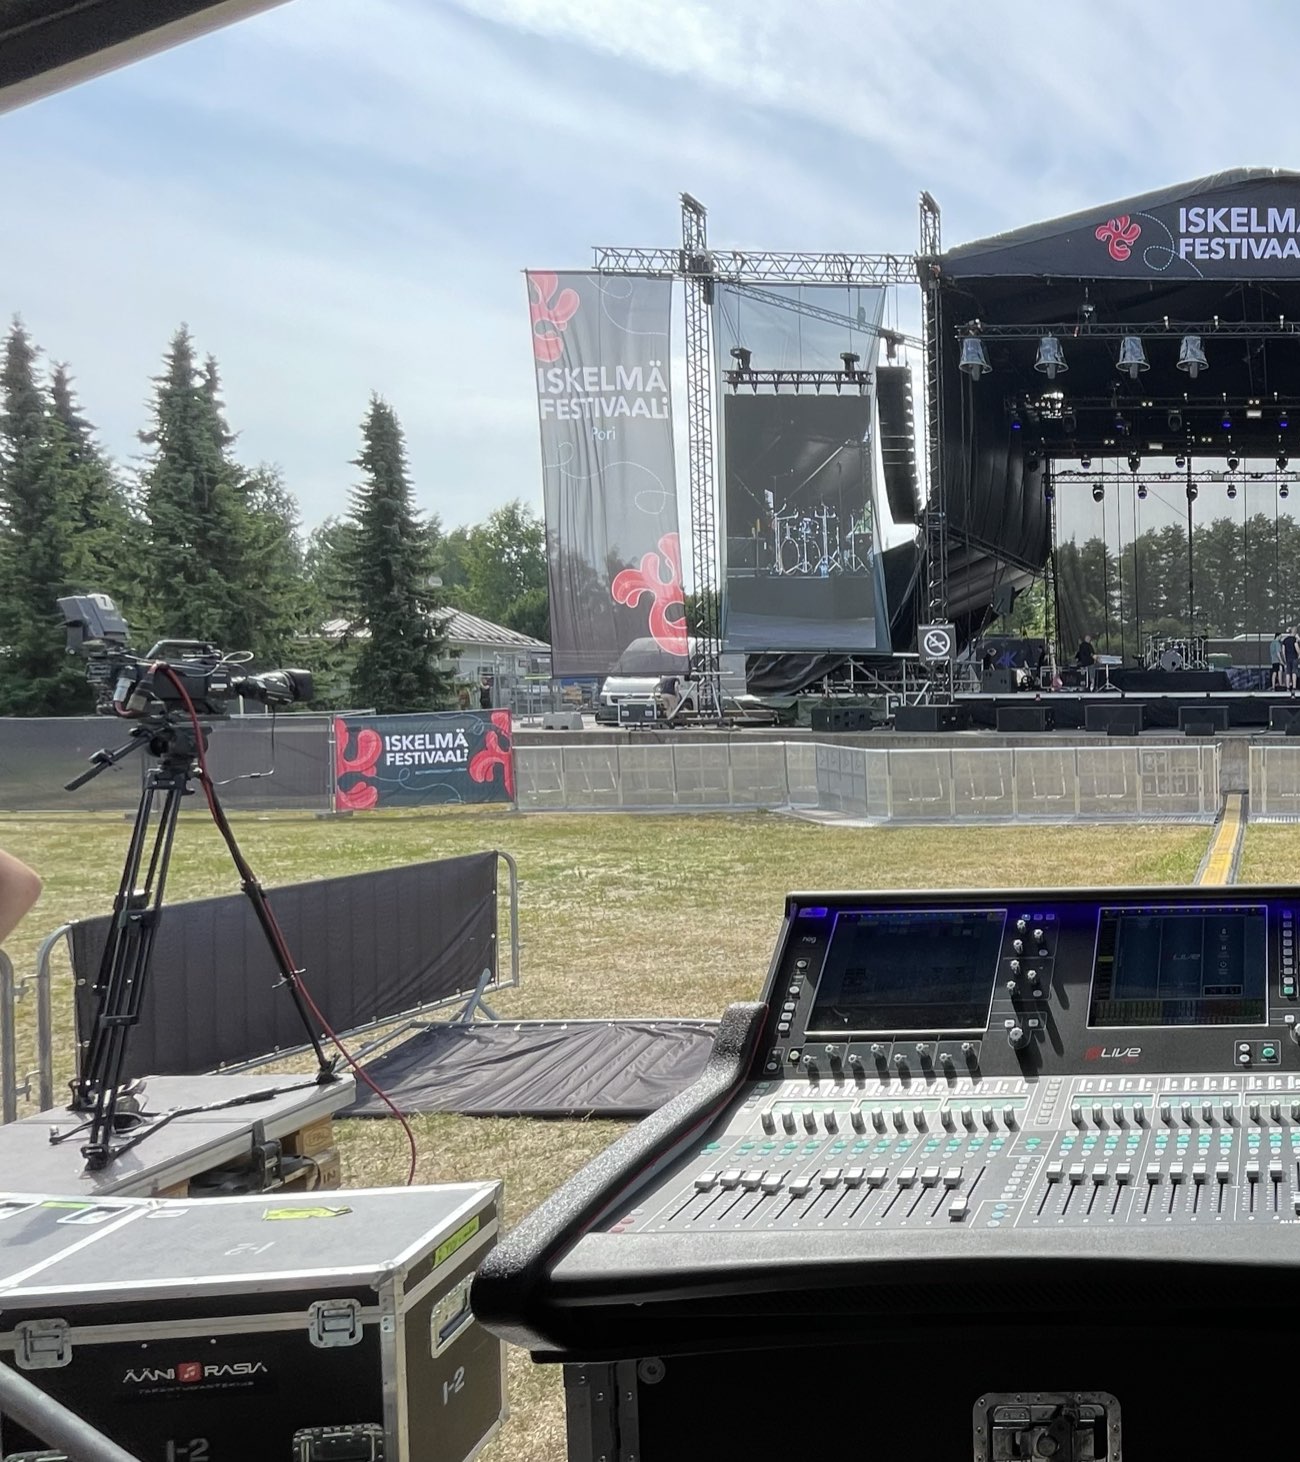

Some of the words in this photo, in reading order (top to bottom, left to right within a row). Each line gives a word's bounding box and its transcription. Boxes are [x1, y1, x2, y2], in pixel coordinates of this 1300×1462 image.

[537, 360, 668, 394] ISKELMÄ
[591, 426, 616, 441] Pori
[385, 728, 469, 751] ISKELMÄ
